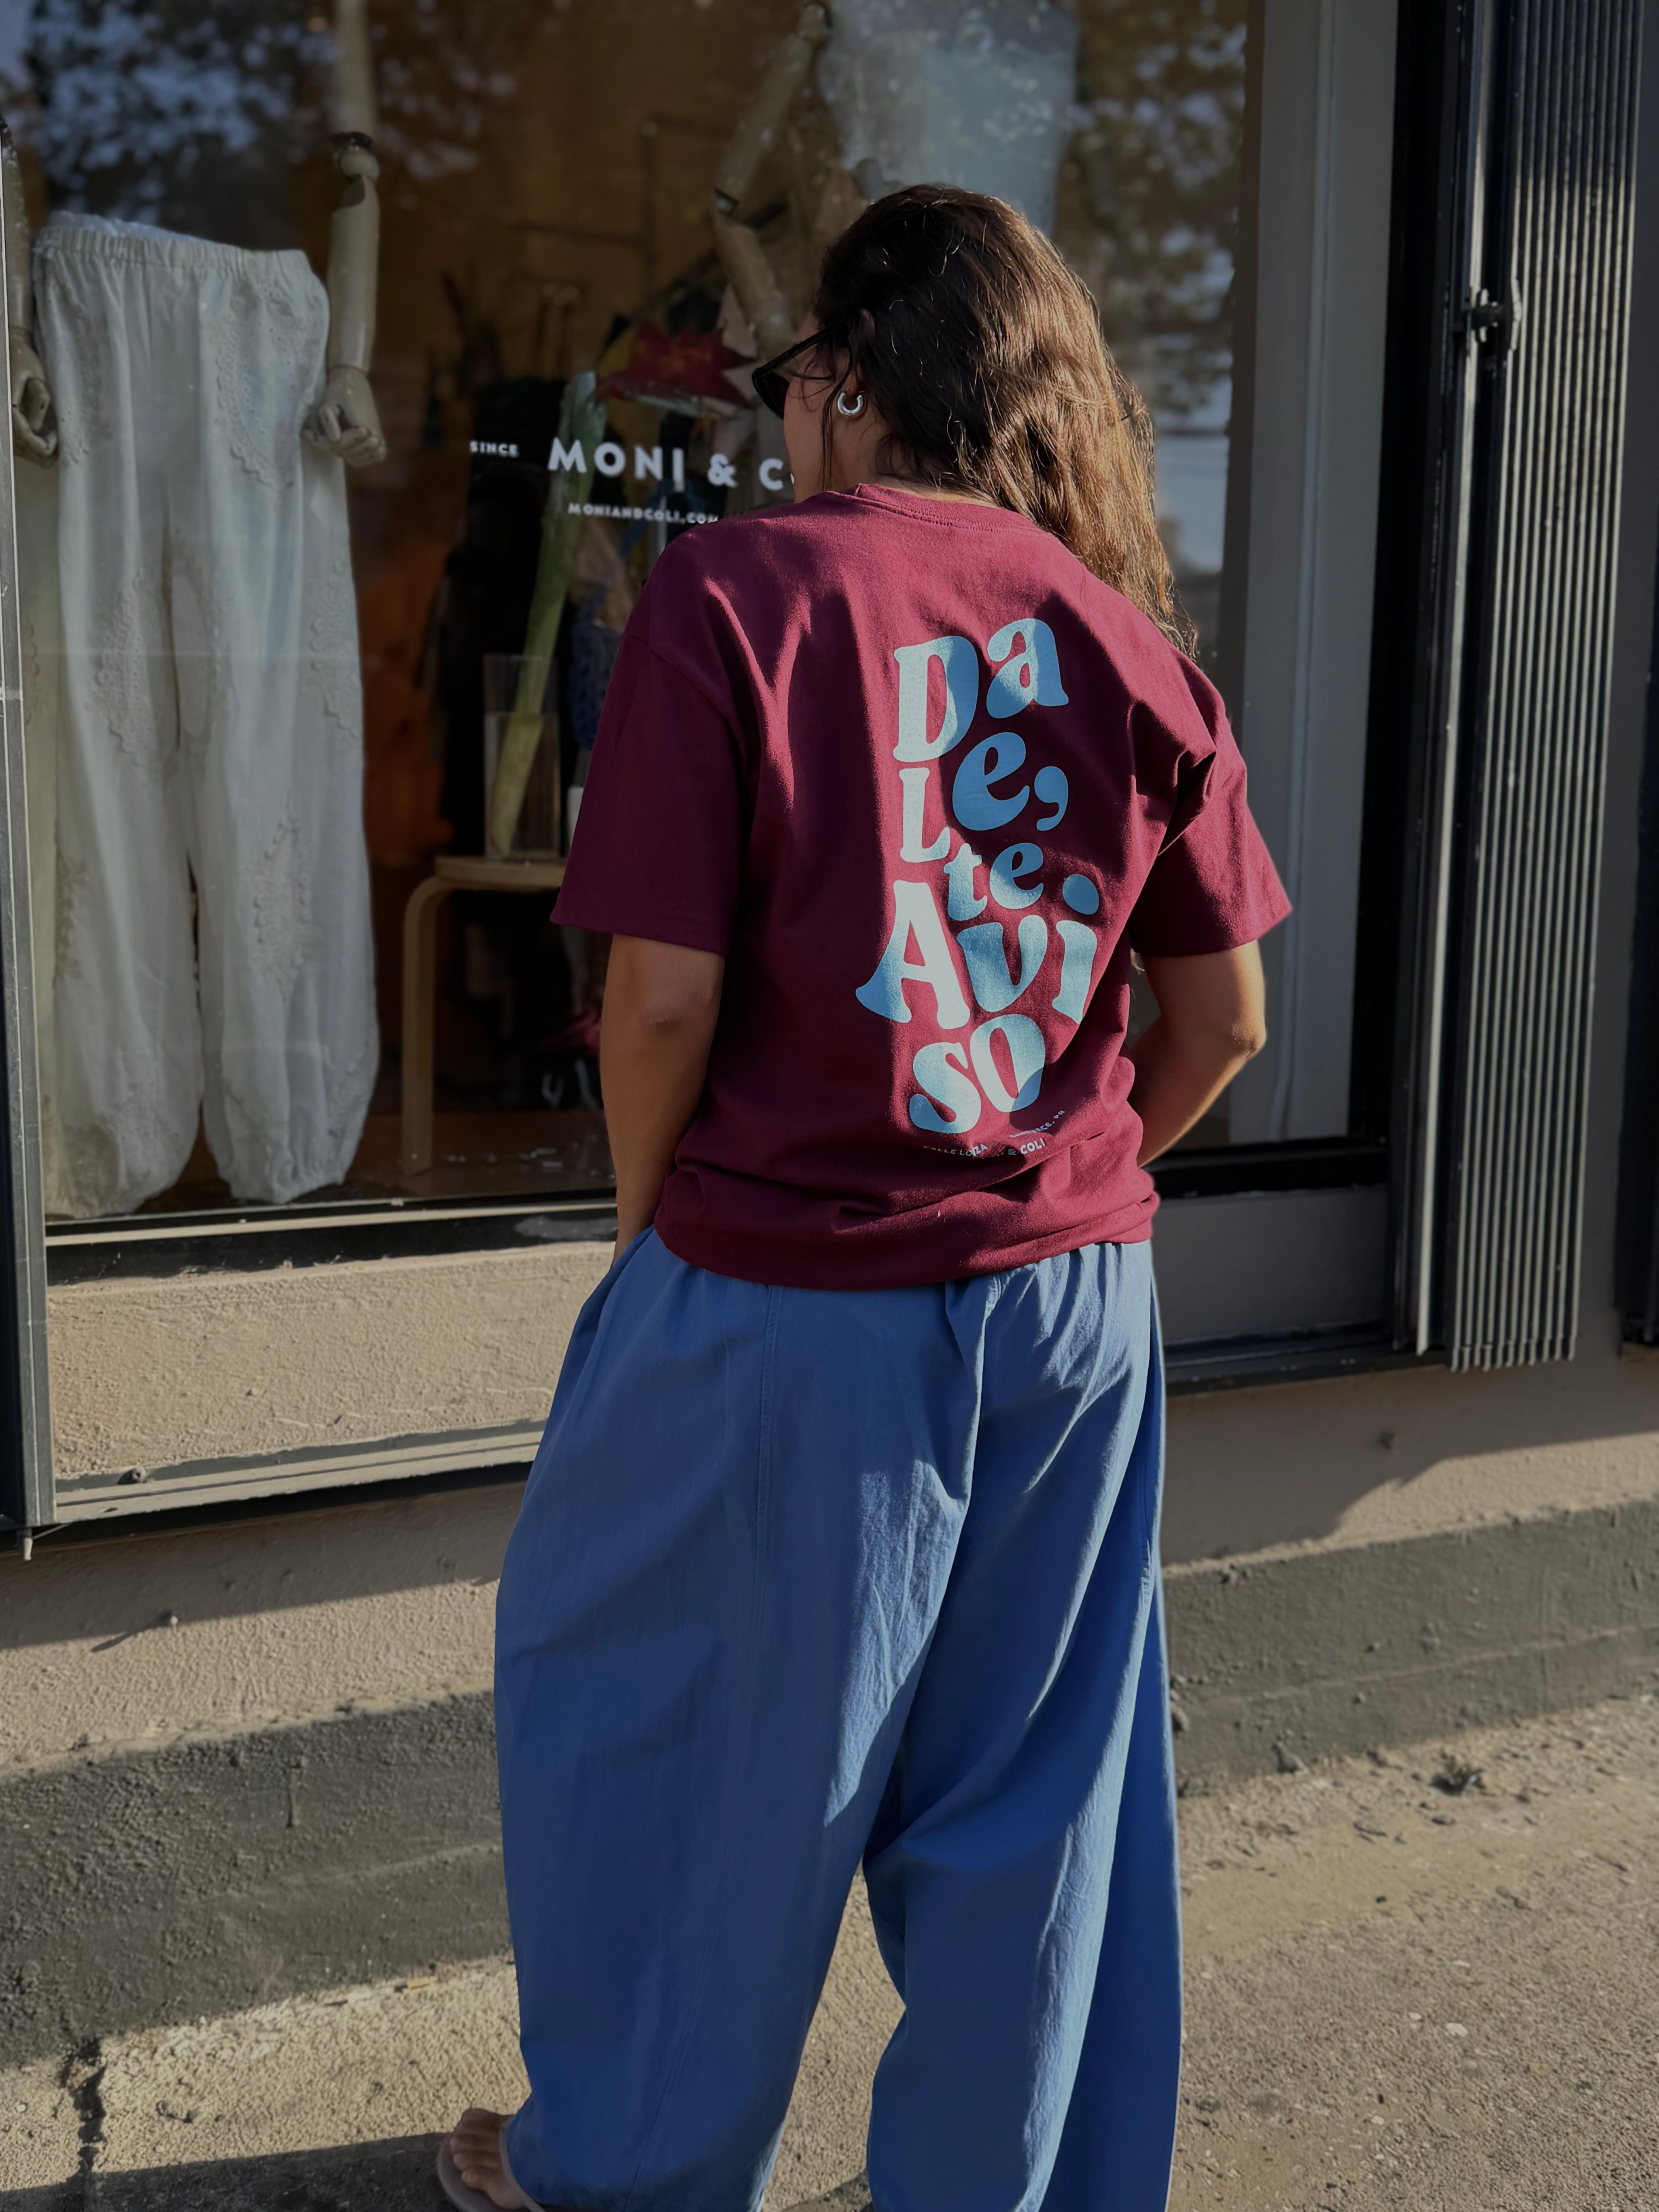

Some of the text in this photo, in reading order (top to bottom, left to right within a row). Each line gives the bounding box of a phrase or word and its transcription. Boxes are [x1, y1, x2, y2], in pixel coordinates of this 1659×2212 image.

[469, 440, 520, 458] SINCE
[548, 437, 795, 492] MONI & C
[1020, 1138, 1046, 1154] COLI
